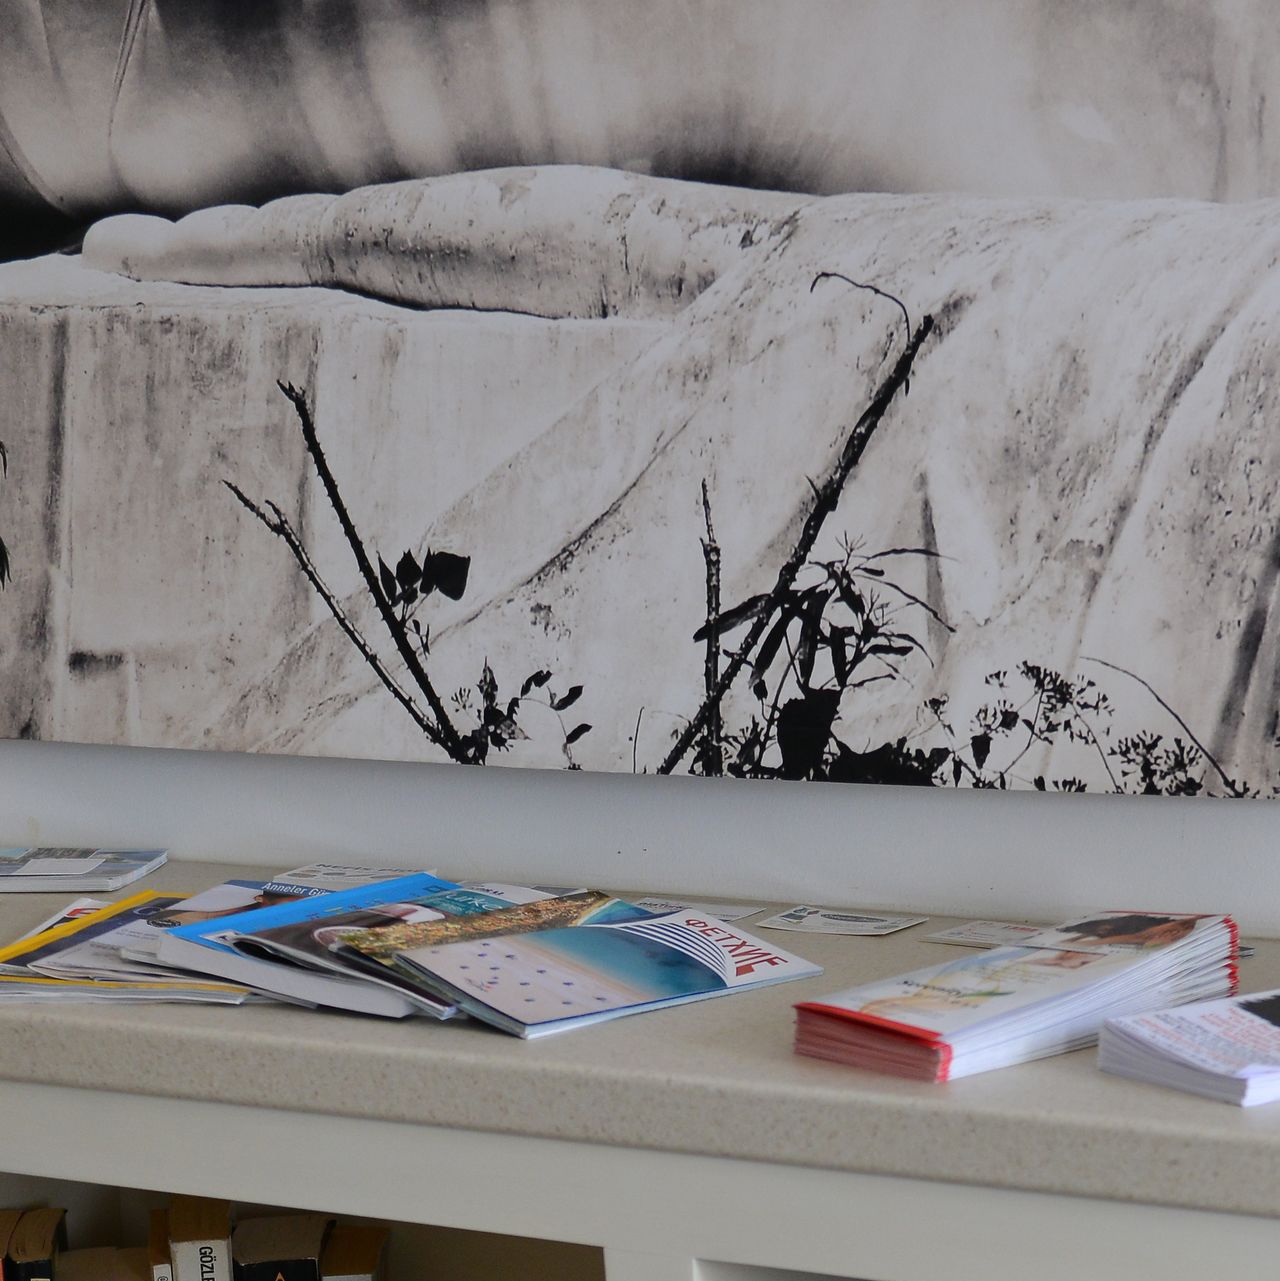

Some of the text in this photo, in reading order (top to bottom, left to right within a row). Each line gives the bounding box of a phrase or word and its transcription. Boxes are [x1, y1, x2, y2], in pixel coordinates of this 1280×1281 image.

[261, 882, 331, 896] Anneler Gü
[685, 918, 788, 969] ФЕТХИЕ
